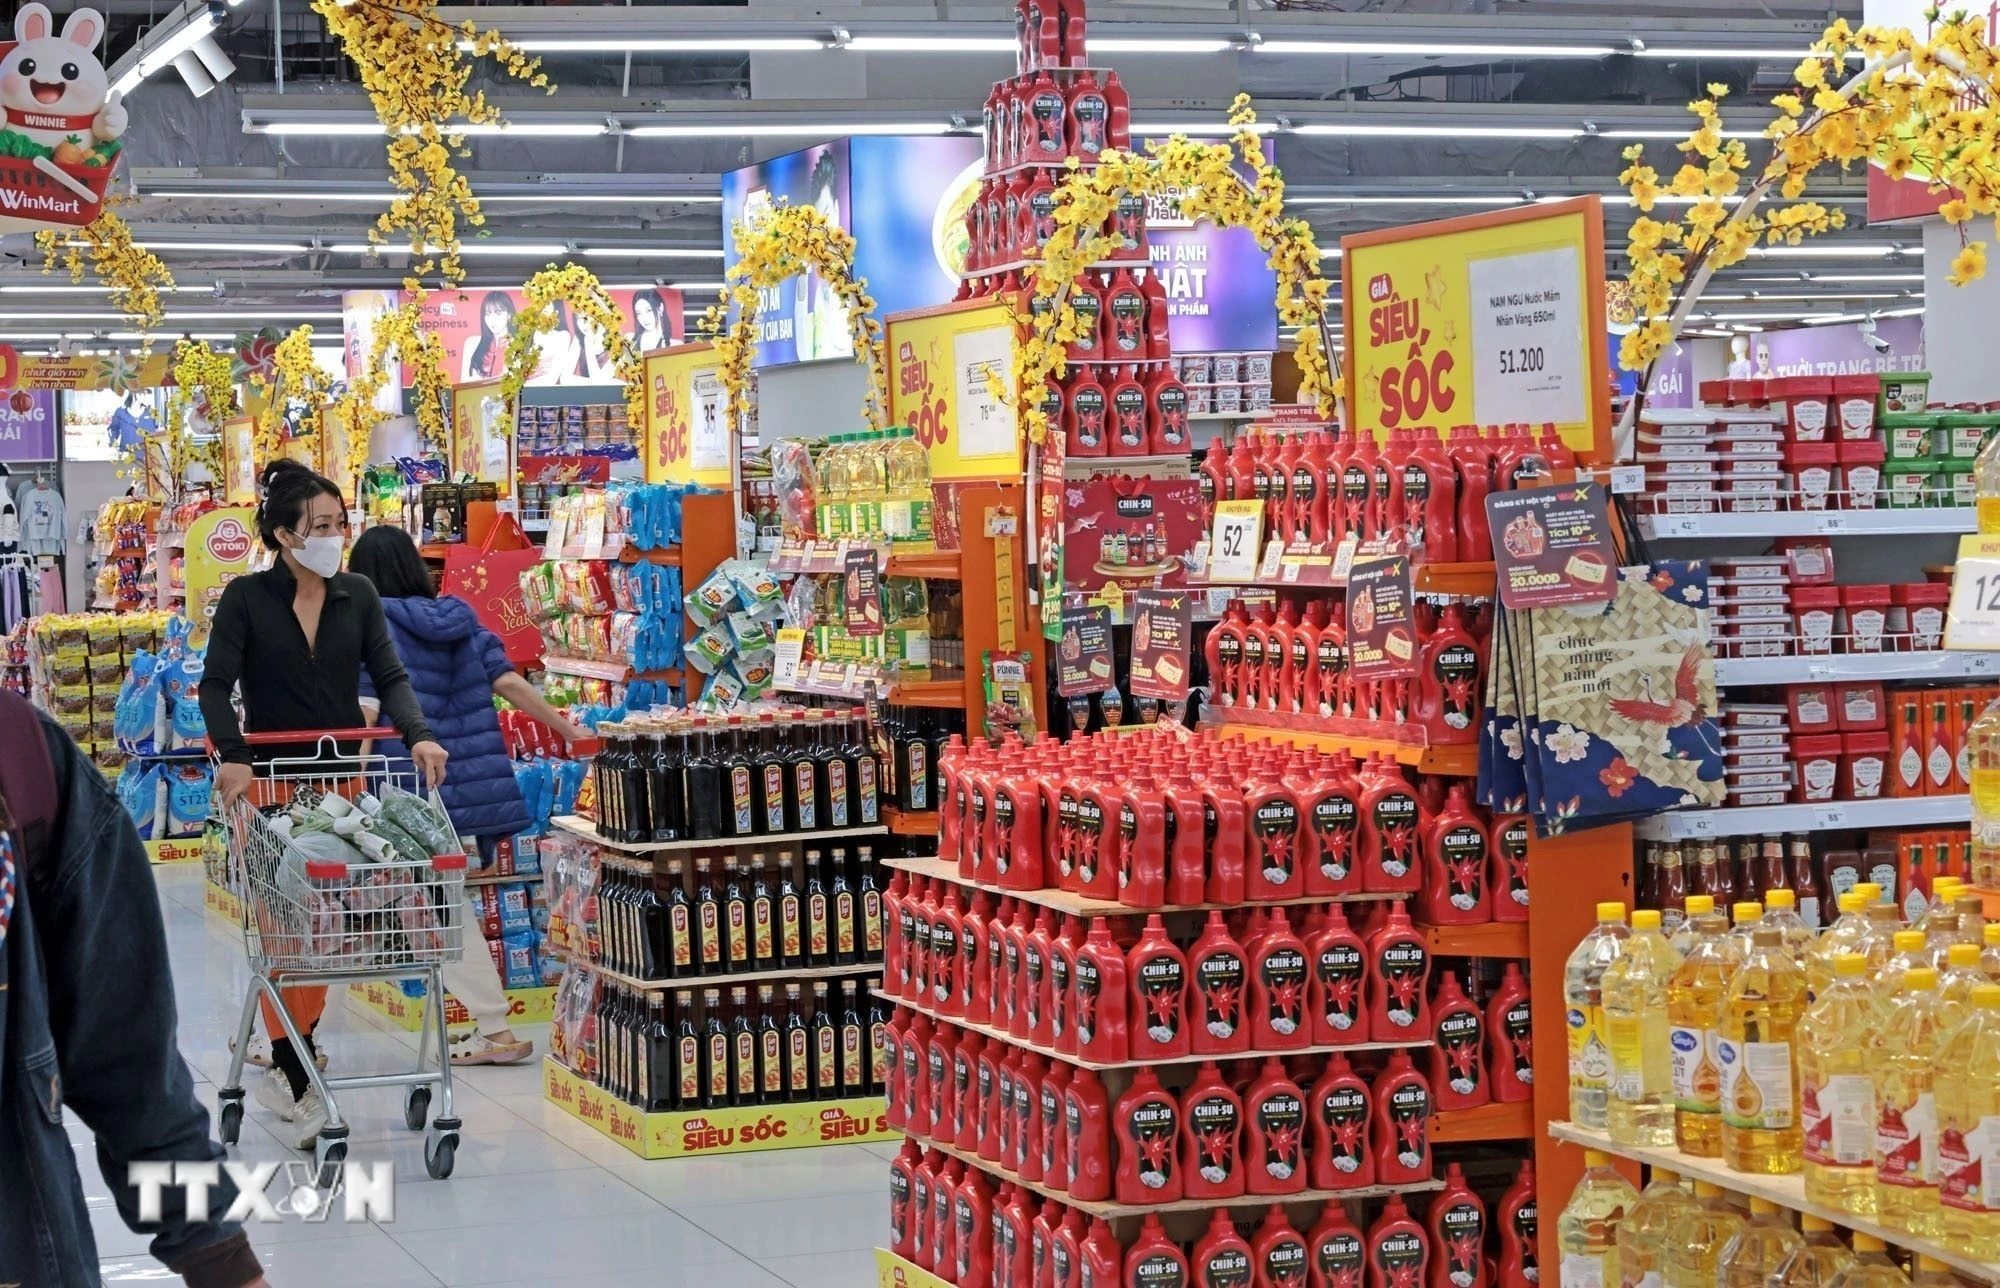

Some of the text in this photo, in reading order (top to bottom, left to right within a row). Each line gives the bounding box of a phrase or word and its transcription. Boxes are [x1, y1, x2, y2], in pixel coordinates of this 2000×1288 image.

[1036, 99, 1061, 107] CHIN-SU
[1078, 101, 1102, 109] CHIN-SU
[24, 114, 66, 128] WINNIE
[0, 187, 80, 214] WinMart
[1175, 240, 1207, 261] ẢNH
[1371, 275, 1389, 299] GIÁ
[1114, 298, 1140, 306] CHIN-SU
[1490, 296, 1506, 307] NAM
[1525, 291, 1543, 304] Nước
[1544, 289, 1560, 302] Mắm
[1180, 301, 1208, 315] PHẨM
[1370, 292, 1420, 348] SIÊU
[1496, 310, 1555, 326] Nhãn Vàng 650ml
[1500, 347, 1544, 374] 51.200
[1816, 358, 1872, 374] TRANG
[901, 355, 928, 396] SIÊU
[1380, 328, 1455, 428] SỐC
[1659, 364, 1683, 394] GÁI
[1077, 394, 1101, 402] CHIN-SU
[1344, 474, 1366, 485] CHIN-SU
[1625, 475, 1636, 484] 30
[1118, 499, 1152, 509] CHIN-SU
[1828, 519, 1838, 528] 88
[1549, 526, 1582, 538] TÍCH 10
[213, 542, 245, 551] OTOKI
[1223, 525, 1243, 556] 52
[1559, 633, 1595, 649] chúc
[1439, 653, 1474, 664] CHIN-SU
[1570, 649, 1613, 664] mừng
[997, 663, 1021, 676] PONNIE
[1564, 667, 1596, 682] năm
[1583, 677, 1611, 693] mới
[179, 794, 208, 806] ST25
[1317, 803, 1352, 815] CHIN-SU
[1378, 801, 1414, 812] CHIN-SU
[1258, 807, 1293, 819] CHIN-SU
[1828, 813, 1839, 822] 88
[1696, 821, 1707, 829] 42
[1444, 834, 1480, 845] CHIN-SU
[159, 848, 187, 860] SIÊU
[1322, 953, 1359, 964] CHIN-SU
[1385, 950, 1422, 960] CHIN-SU
[1202, 960, 1239, 972] CHIN-SU
[1266, 956, 1303, 968] CHIN-SU
[1143, 964, 1179, 976] CHIN-SU
[1441, 1018, 1477, 1031] CHIN-SU
[1326, 1095, 1363, 1106] CHIN-SU
[1393, 1090, 1425, 1103] CHIN-SU
[1195, 1105, 1233, 1116] CHIN-SU
[1262, 1101, 1299, 1113] CHIN-SU
[823, 1108, 840, 1120] GIÁ
[1134, 1109, 1171, 1121] CHIN-SU
[685, 1119, 703, 1130] GIÁ
[820, 1114, 869, 1140] SIÊU
[683, 1114, 787, 1151] SIÊU SỐC
[1445, 1211, 1479, 1222] CHIN-SU
[1323, 1242, 1359, 1253] CHIN-SU
[1382, 1240, 1419, 1251] CHIN-SU
[1270, 1249, 1303, 1261] CHIN-SU
[1138, 1263, 1177, 1275] CHIN-SU
[1210, 1257, 1246, 1269] CHIN-SU
